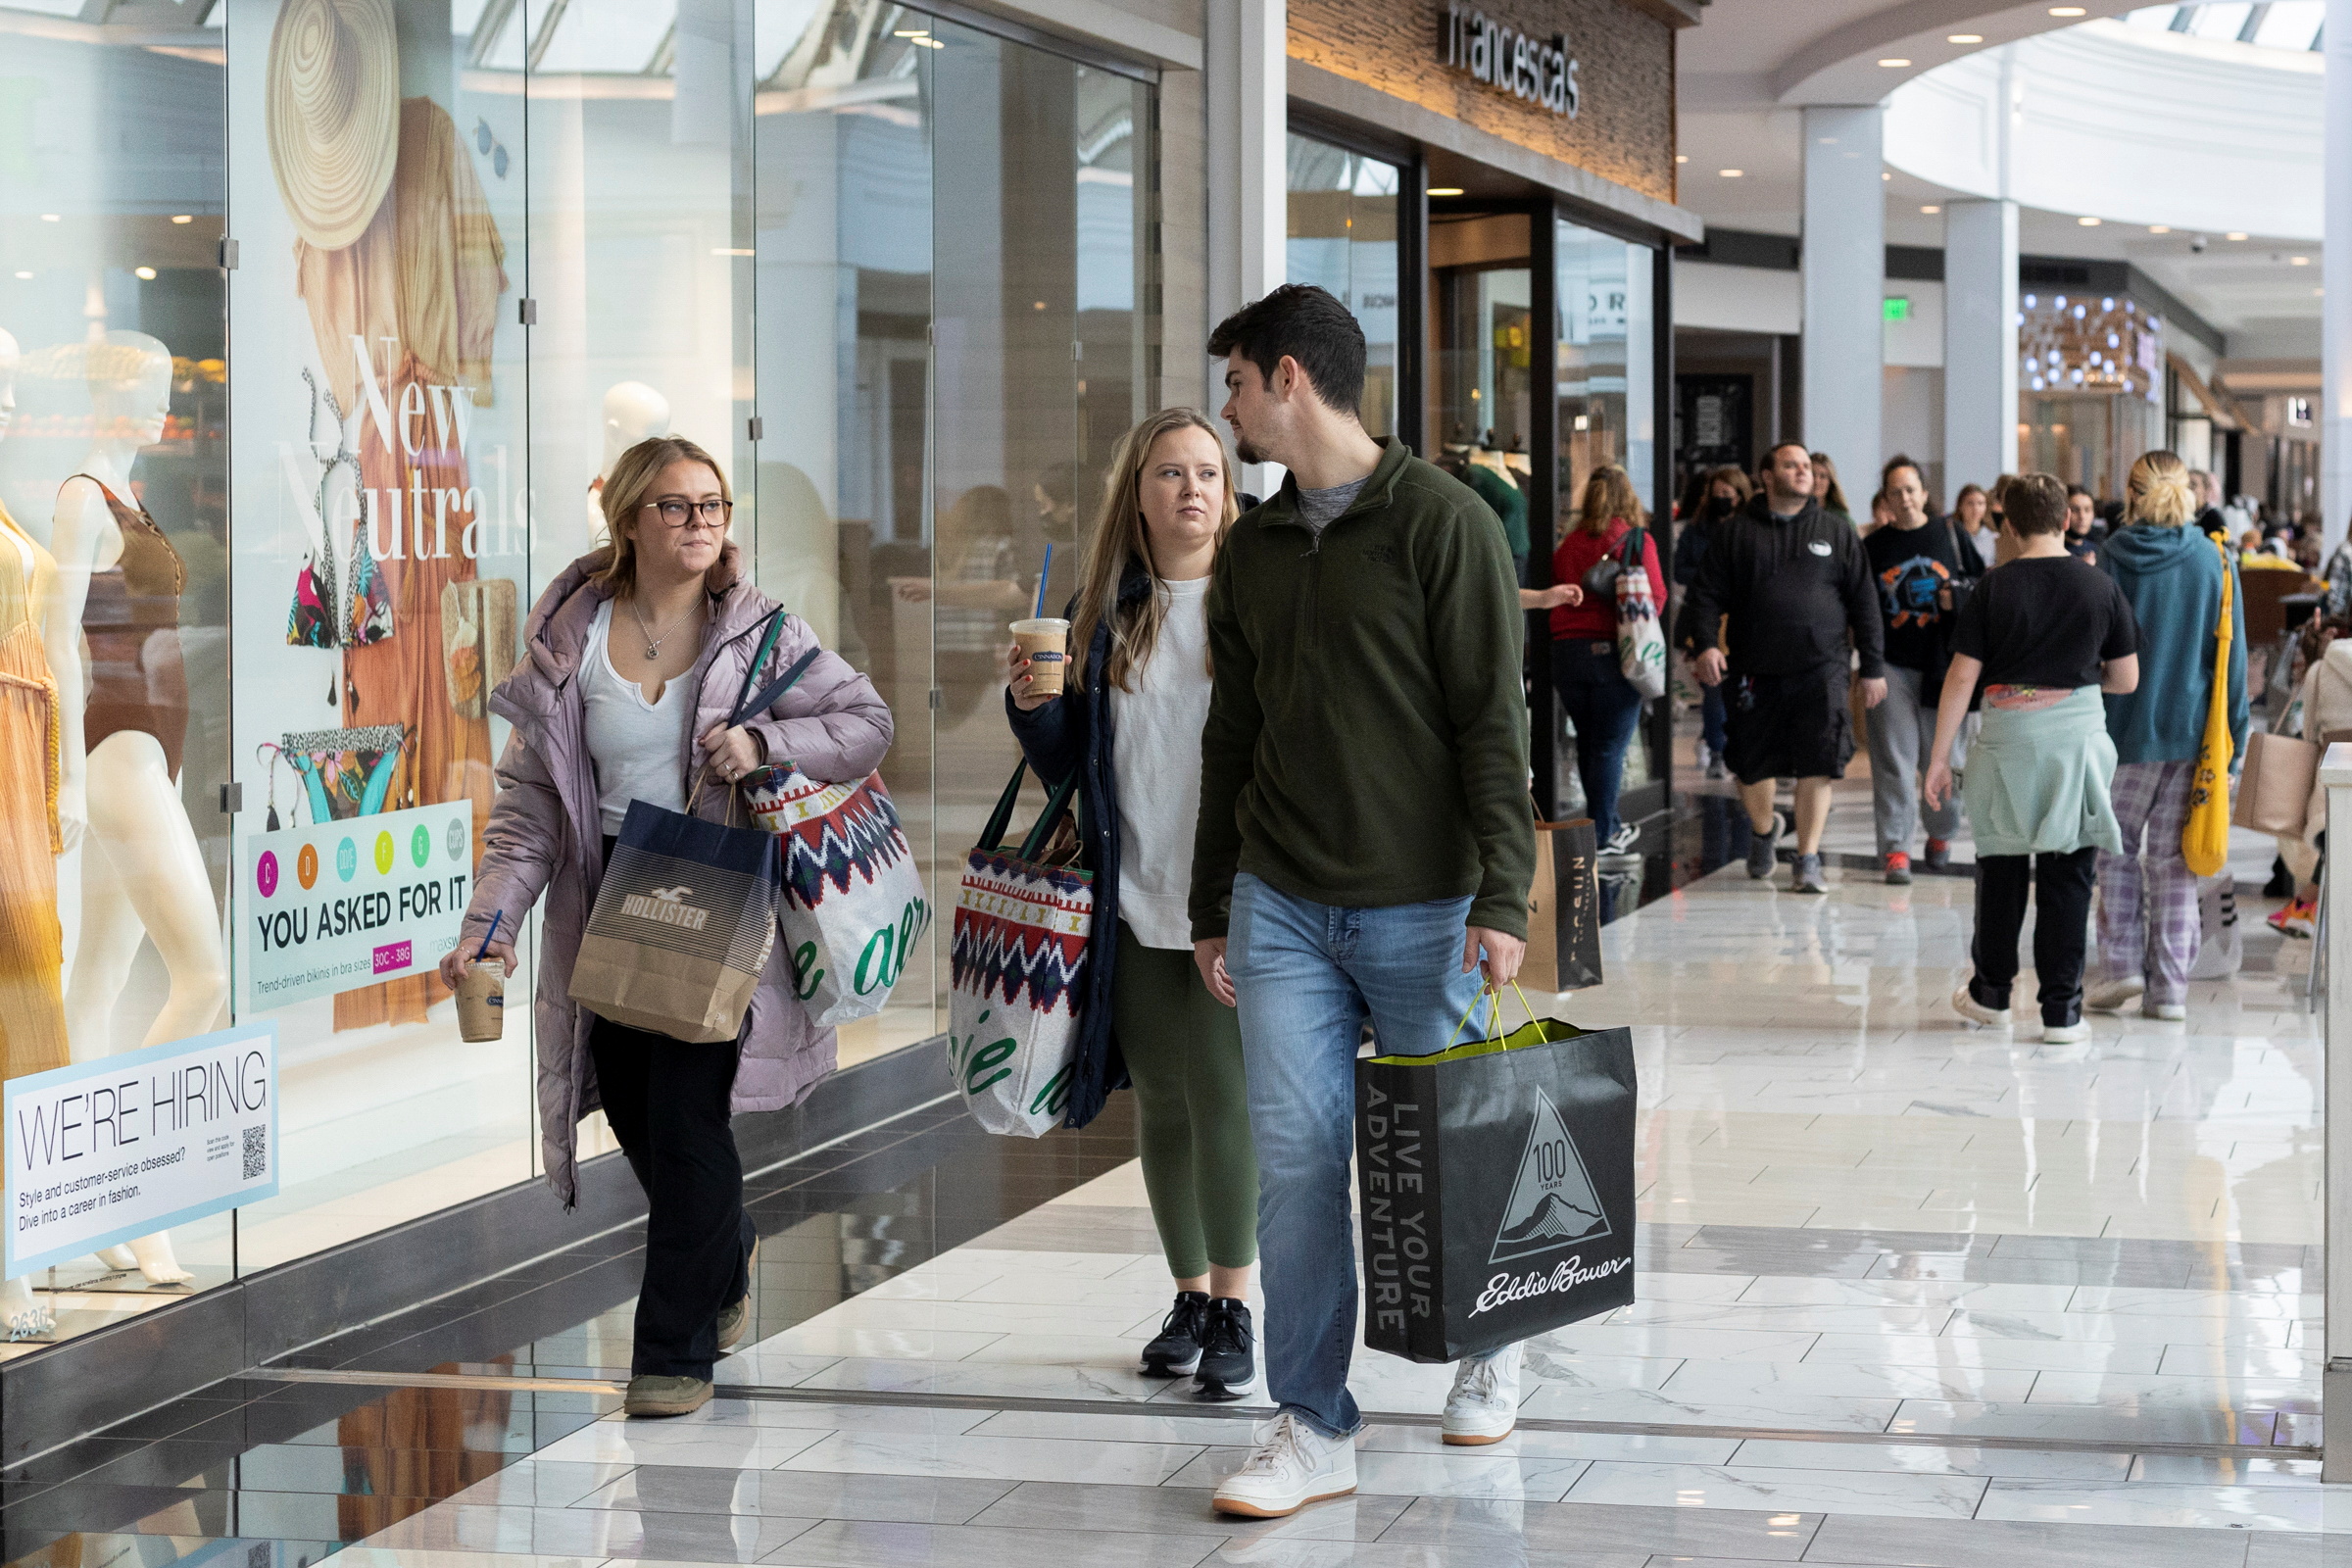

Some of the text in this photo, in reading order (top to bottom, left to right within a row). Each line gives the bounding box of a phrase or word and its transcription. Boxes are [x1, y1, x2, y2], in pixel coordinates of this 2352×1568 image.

[349, 334, 477, 460] New
[275, 441, 537, 564] Neutrals
[447, 828, 464, 850] CUPS
[257, 875, 466, 952] YOU ASKED FOR IT
[621, 894, 709, 931] HOLLISTER
[257, 973, 306, 995] Trend-driven
[306, 966, 330, 983] bikinis
[331, 965, 339, 978] in
[340, 959, 352, 974] bra
[354, 957, 371, 972] sizes
[374, 952, 390, 967] 30C
[395, 947, 411, 963] 38G
[19, 1051, 267, 1171] WE'RE HIRING
[19, 1146, 186, 1208] Style and customer-service obsessed?
[1533, 1139, 1566, 1184] 100
[1541, 1180, 1563, 1192] YEARS
[19, 1183, 141, 1232] Dive into a career in fashion.
[1366, 1082, 1405, 1331] ADVENTURE
[1393, 1103, 1431, 1319] LIVE YOUR
[1468, 1254, 1632, 1319] Eddie Bauer
